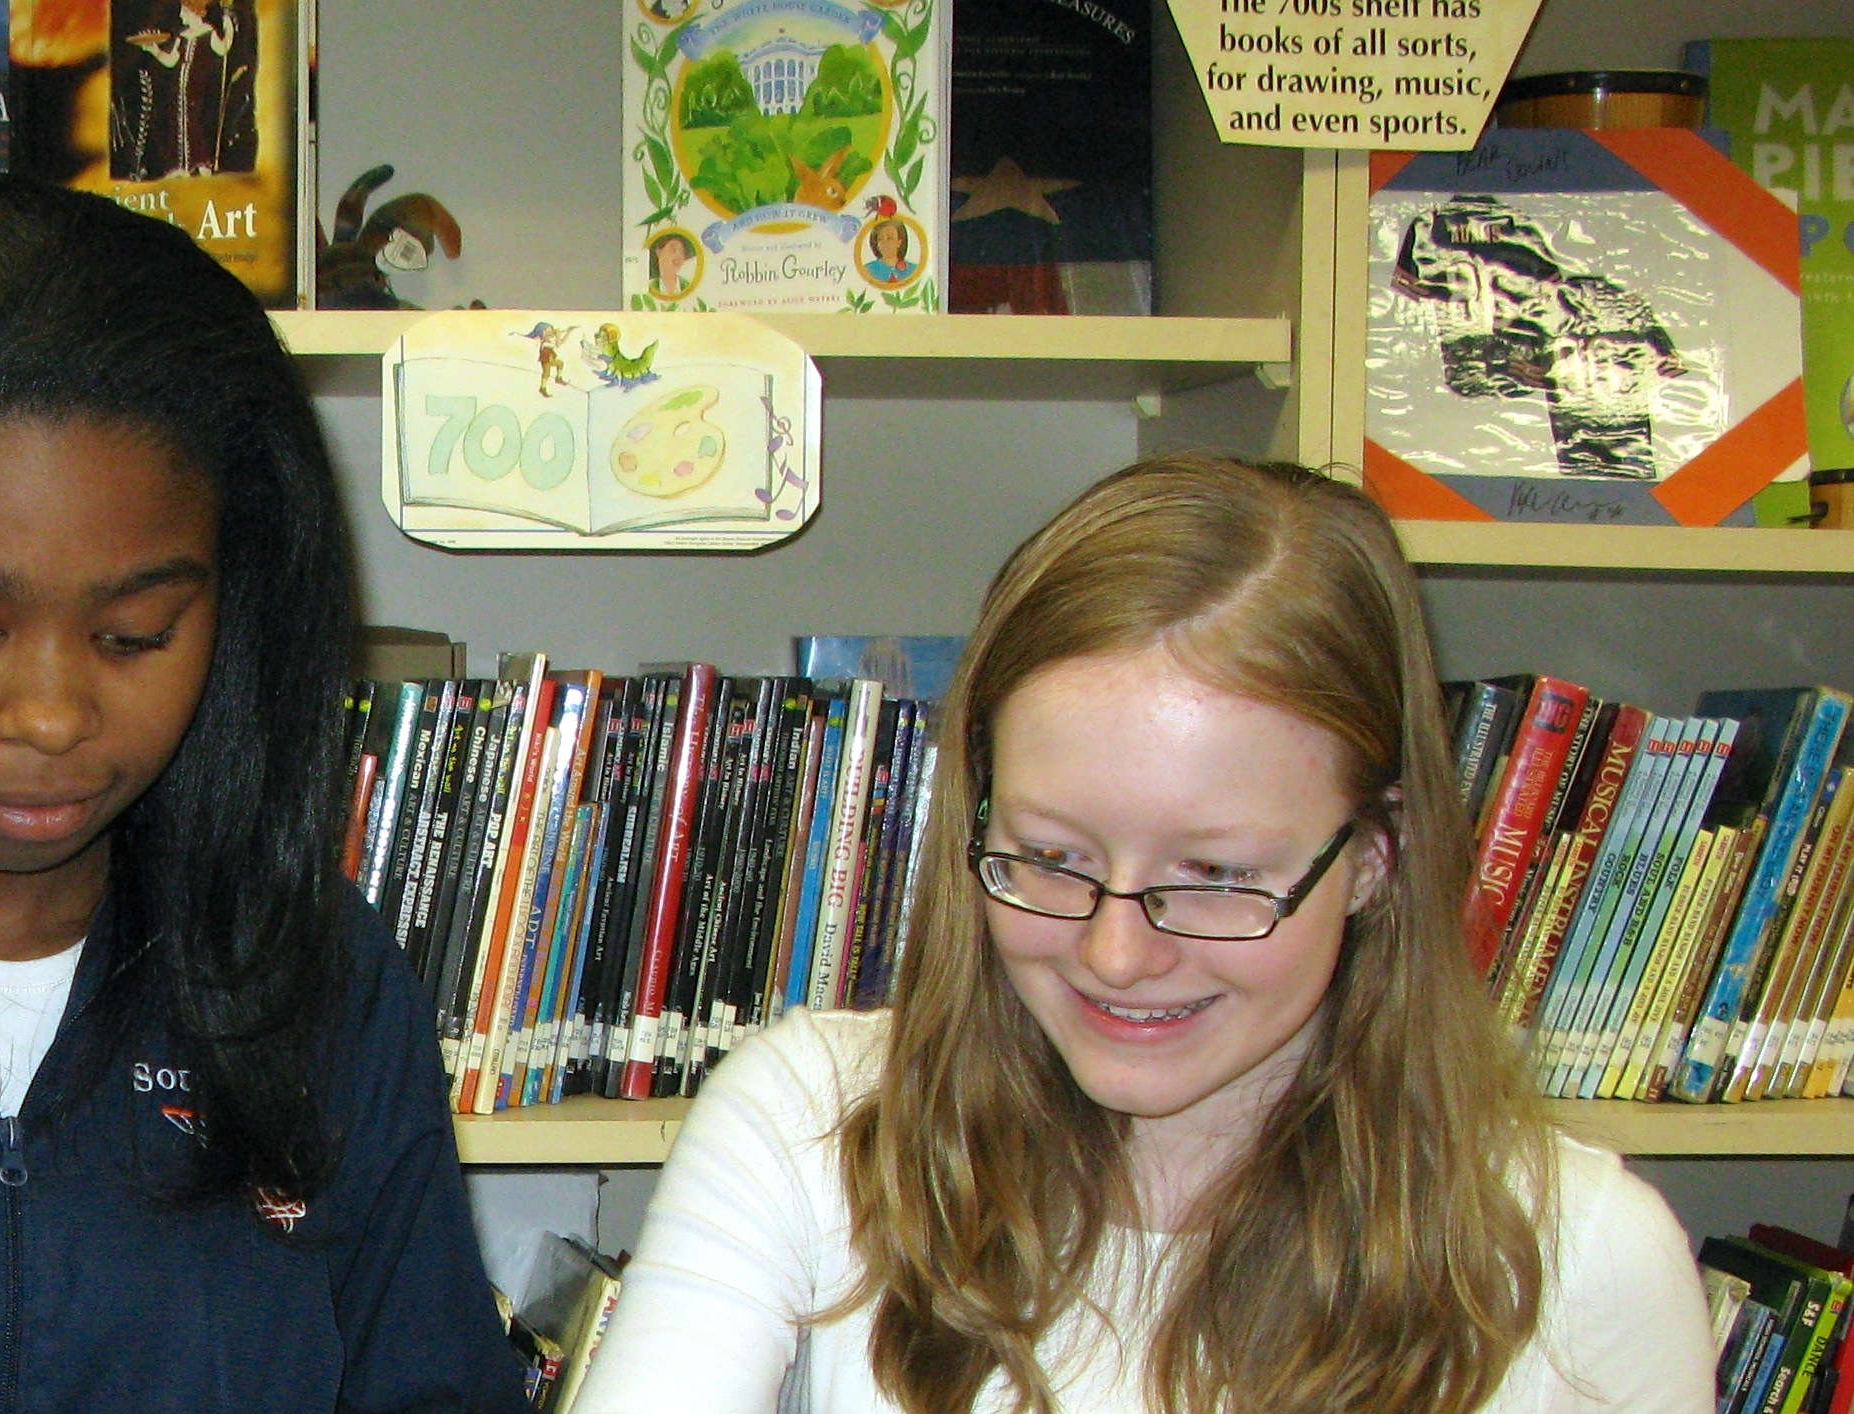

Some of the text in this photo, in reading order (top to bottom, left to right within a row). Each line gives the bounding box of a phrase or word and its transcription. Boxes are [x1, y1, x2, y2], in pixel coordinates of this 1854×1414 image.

[1219, 23, 1477, 63] books of all sorts,
[1206, 63, 1491, 103] for drawing, music,
[1229, 103, 1467, 142] and even sports.
[196, 200, 257, 239] Art
[720, 254, 847, 285] Robbin Gourley
[426, 395, 575, 491] 700
[410, 728, 432, 789] Mexican
[465, 725, 485, 784] Chinese
[477, 732, 499, 803] Japanese
[654, 720, 674, 772] Islamic
[1577, 739, 1631, 849] MUSICAL
[480, 811, 501, 868] POP ART
[616, 805, 635, 883] SURREALISM
[415, 811, 447, 928] THE RENAISSANCE
[1474, 820, 1527, 907] MUSIC
[1587, 851, 1615, 914] COUNTRY
[1611, 853, 1630, 889] ROCK
[1625, 852, 1647, 896] BLUES
[1664, 854, 1682, 890] FOLK
[826, 866, 846, 910] BIG
[1623, 851, 1664, 947] SOUL AND R&B
[819, 922, 836, 968] David
[1800, 1300, 1819, 1327] S&F
[1766, 1364, 1790, 1406] Search
[1763, 1405, 1773, 1414] &
